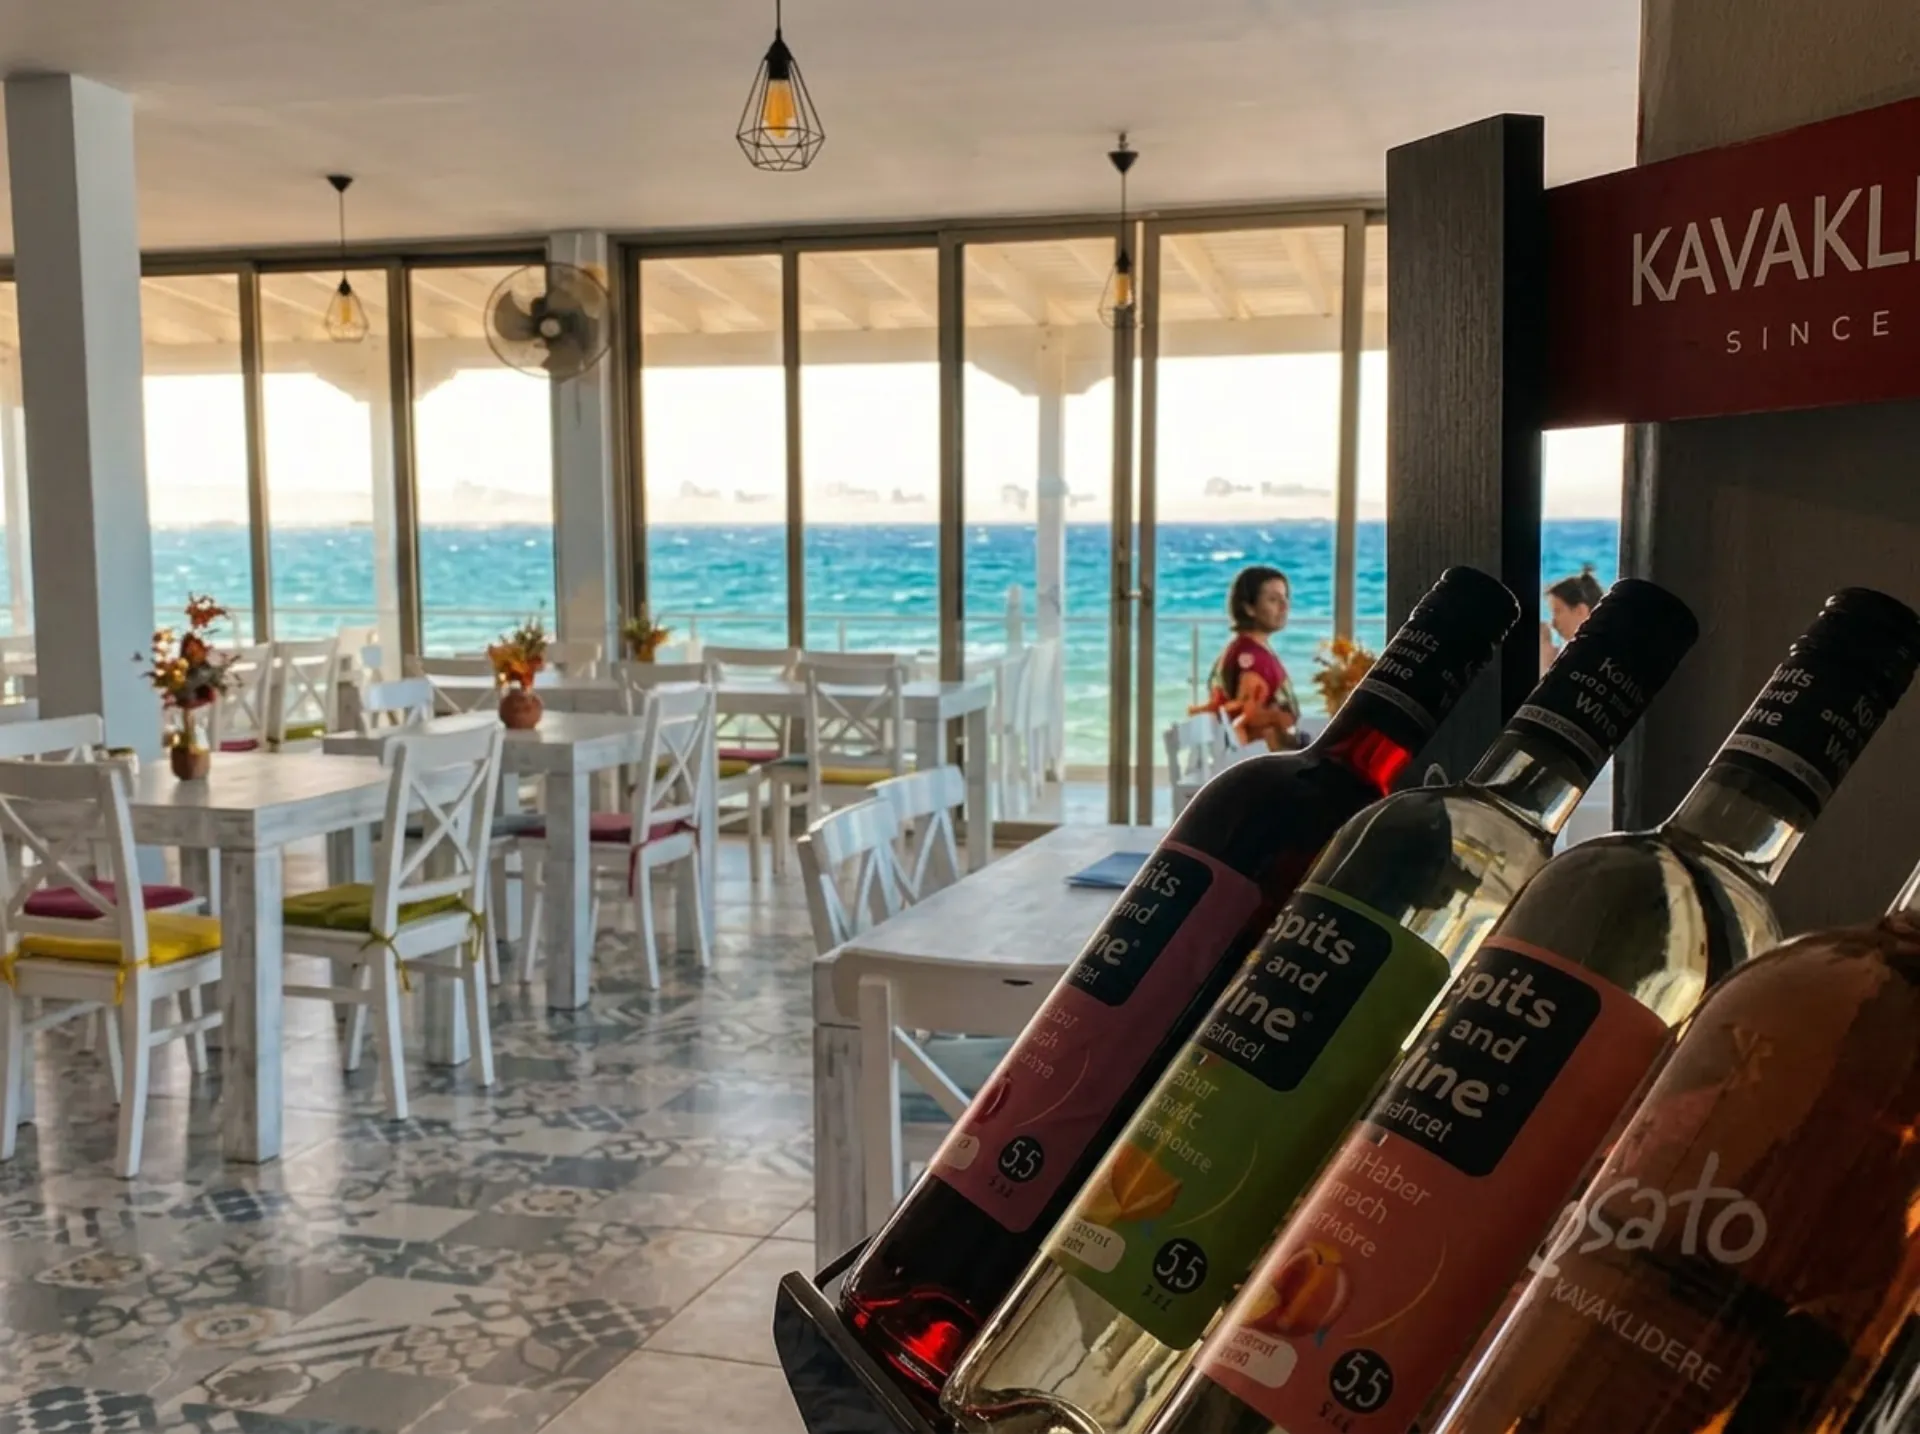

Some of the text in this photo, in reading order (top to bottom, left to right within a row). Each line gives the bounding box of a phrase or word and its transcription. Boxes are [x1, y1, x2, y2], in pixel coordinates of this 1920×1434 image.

[1727, 310, 1890, 353] SINCE
[1265, 956, 1328, 995] and
[1451, 1018, 1528, 1064] and
[1001, 1139, 1041, 1179] 5,5
[1156, 1243, 1205, 1289] 5,5
[1549, 1279, 1723, 1391] KAVAKLIDERE
[1333, 1351, 1390, 1408] 5,5
